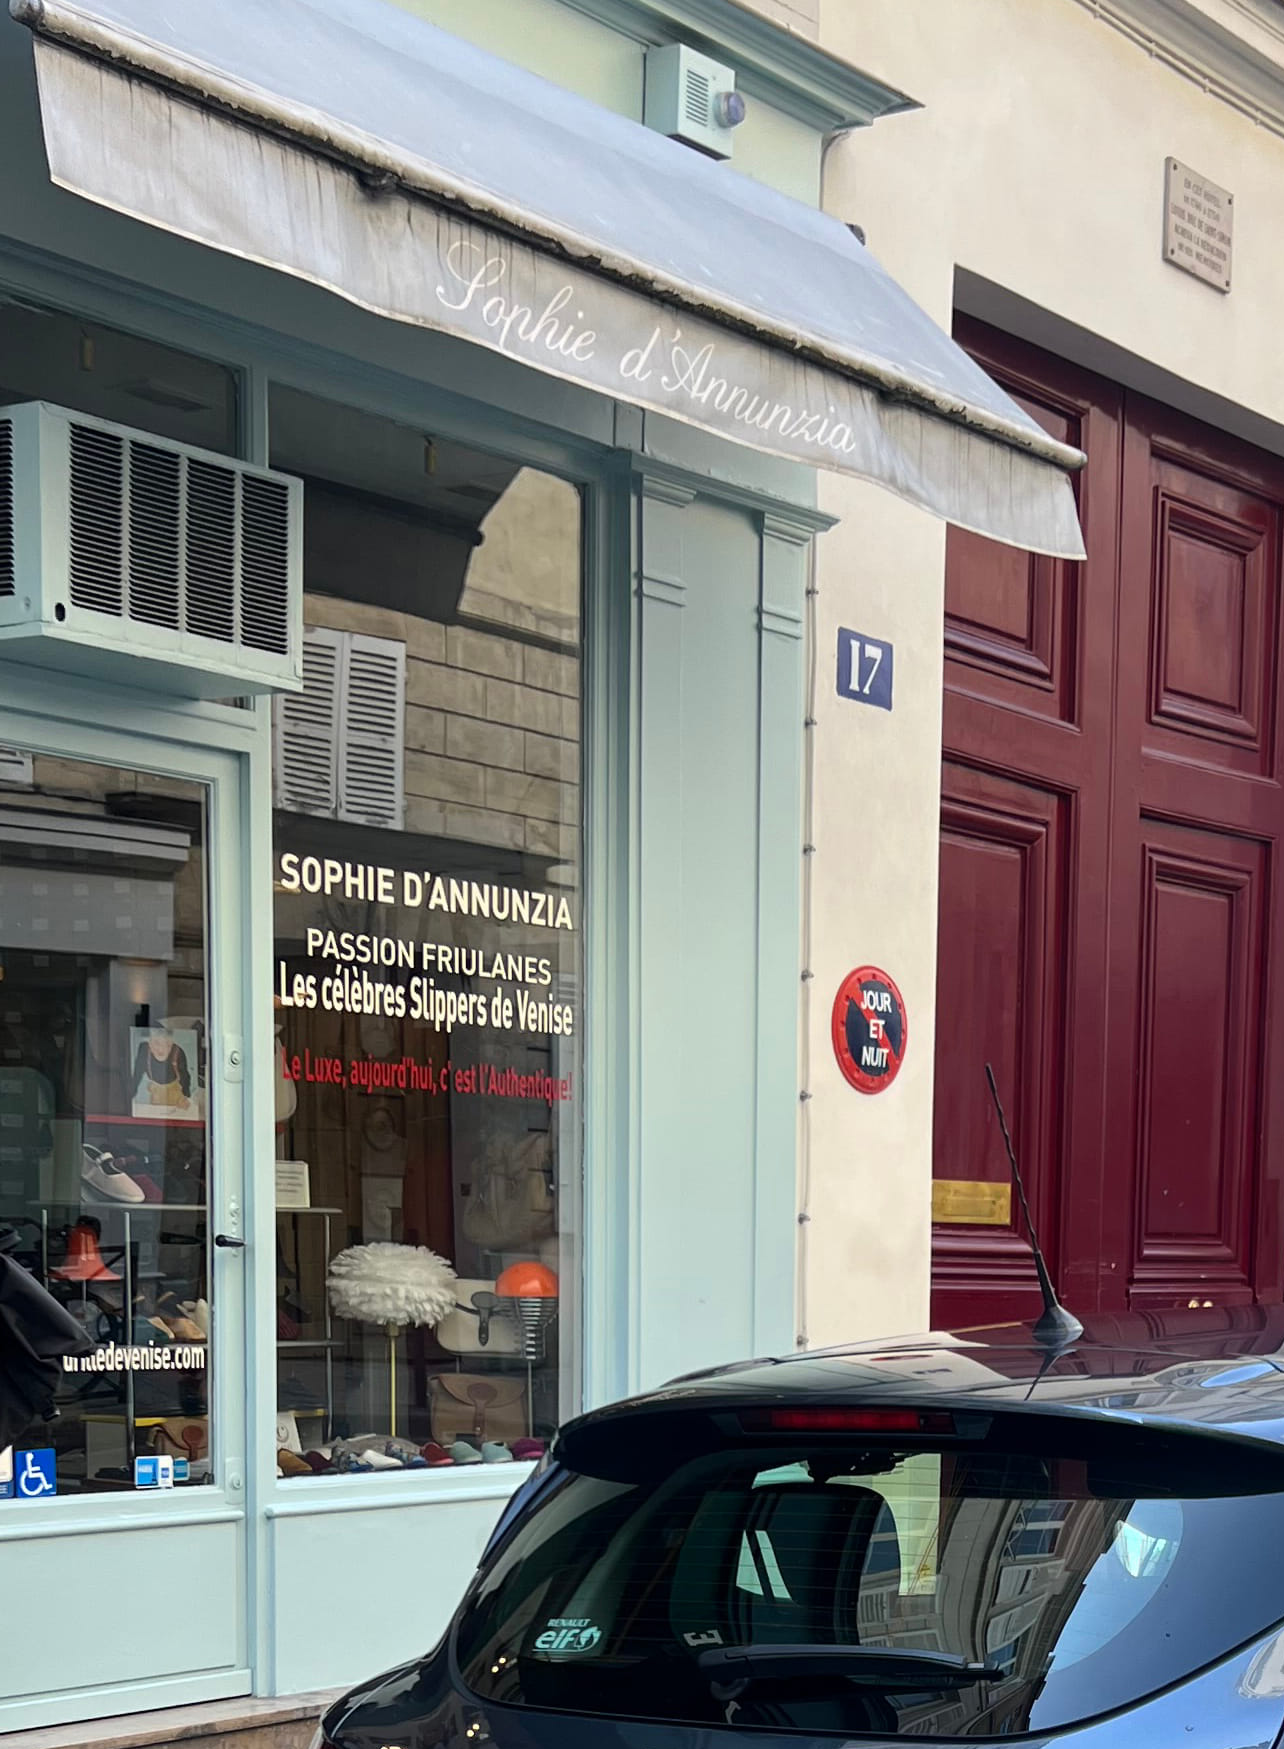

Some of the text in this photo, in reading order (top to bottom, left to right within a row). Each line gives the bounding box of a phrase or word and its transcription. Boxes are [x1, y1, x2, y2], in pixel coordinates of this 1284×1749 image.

[435, 241, 857, 454] Sophie d'Annunzia
[848, 638, 883, 695] 17
[280, 852, 573, 930] SOPHIE D'ANNUNZIA
[306, 927, 552, 986] PASSION FRIULANES
[280, 961, 573, 1036] Les célèbres Slippers de Venise
[860, 990, 892, 1013] JOUR
[861, 1045, 889, 1068] NUIT
[869, 1019, 885, 1040] ET
[281, 1046, 301, 1080] Le
[305, 1048, 346, 1089] Luxe,
[351, 1053, 437, 1096] aujourd'hui,
[455, 1064, 476, 1094] est
[478, 1063, 573, 1107] l'Authentique!
[535, 1629, 580, 1648] elf
[547, 1618, 591, 1627] RENAULT
